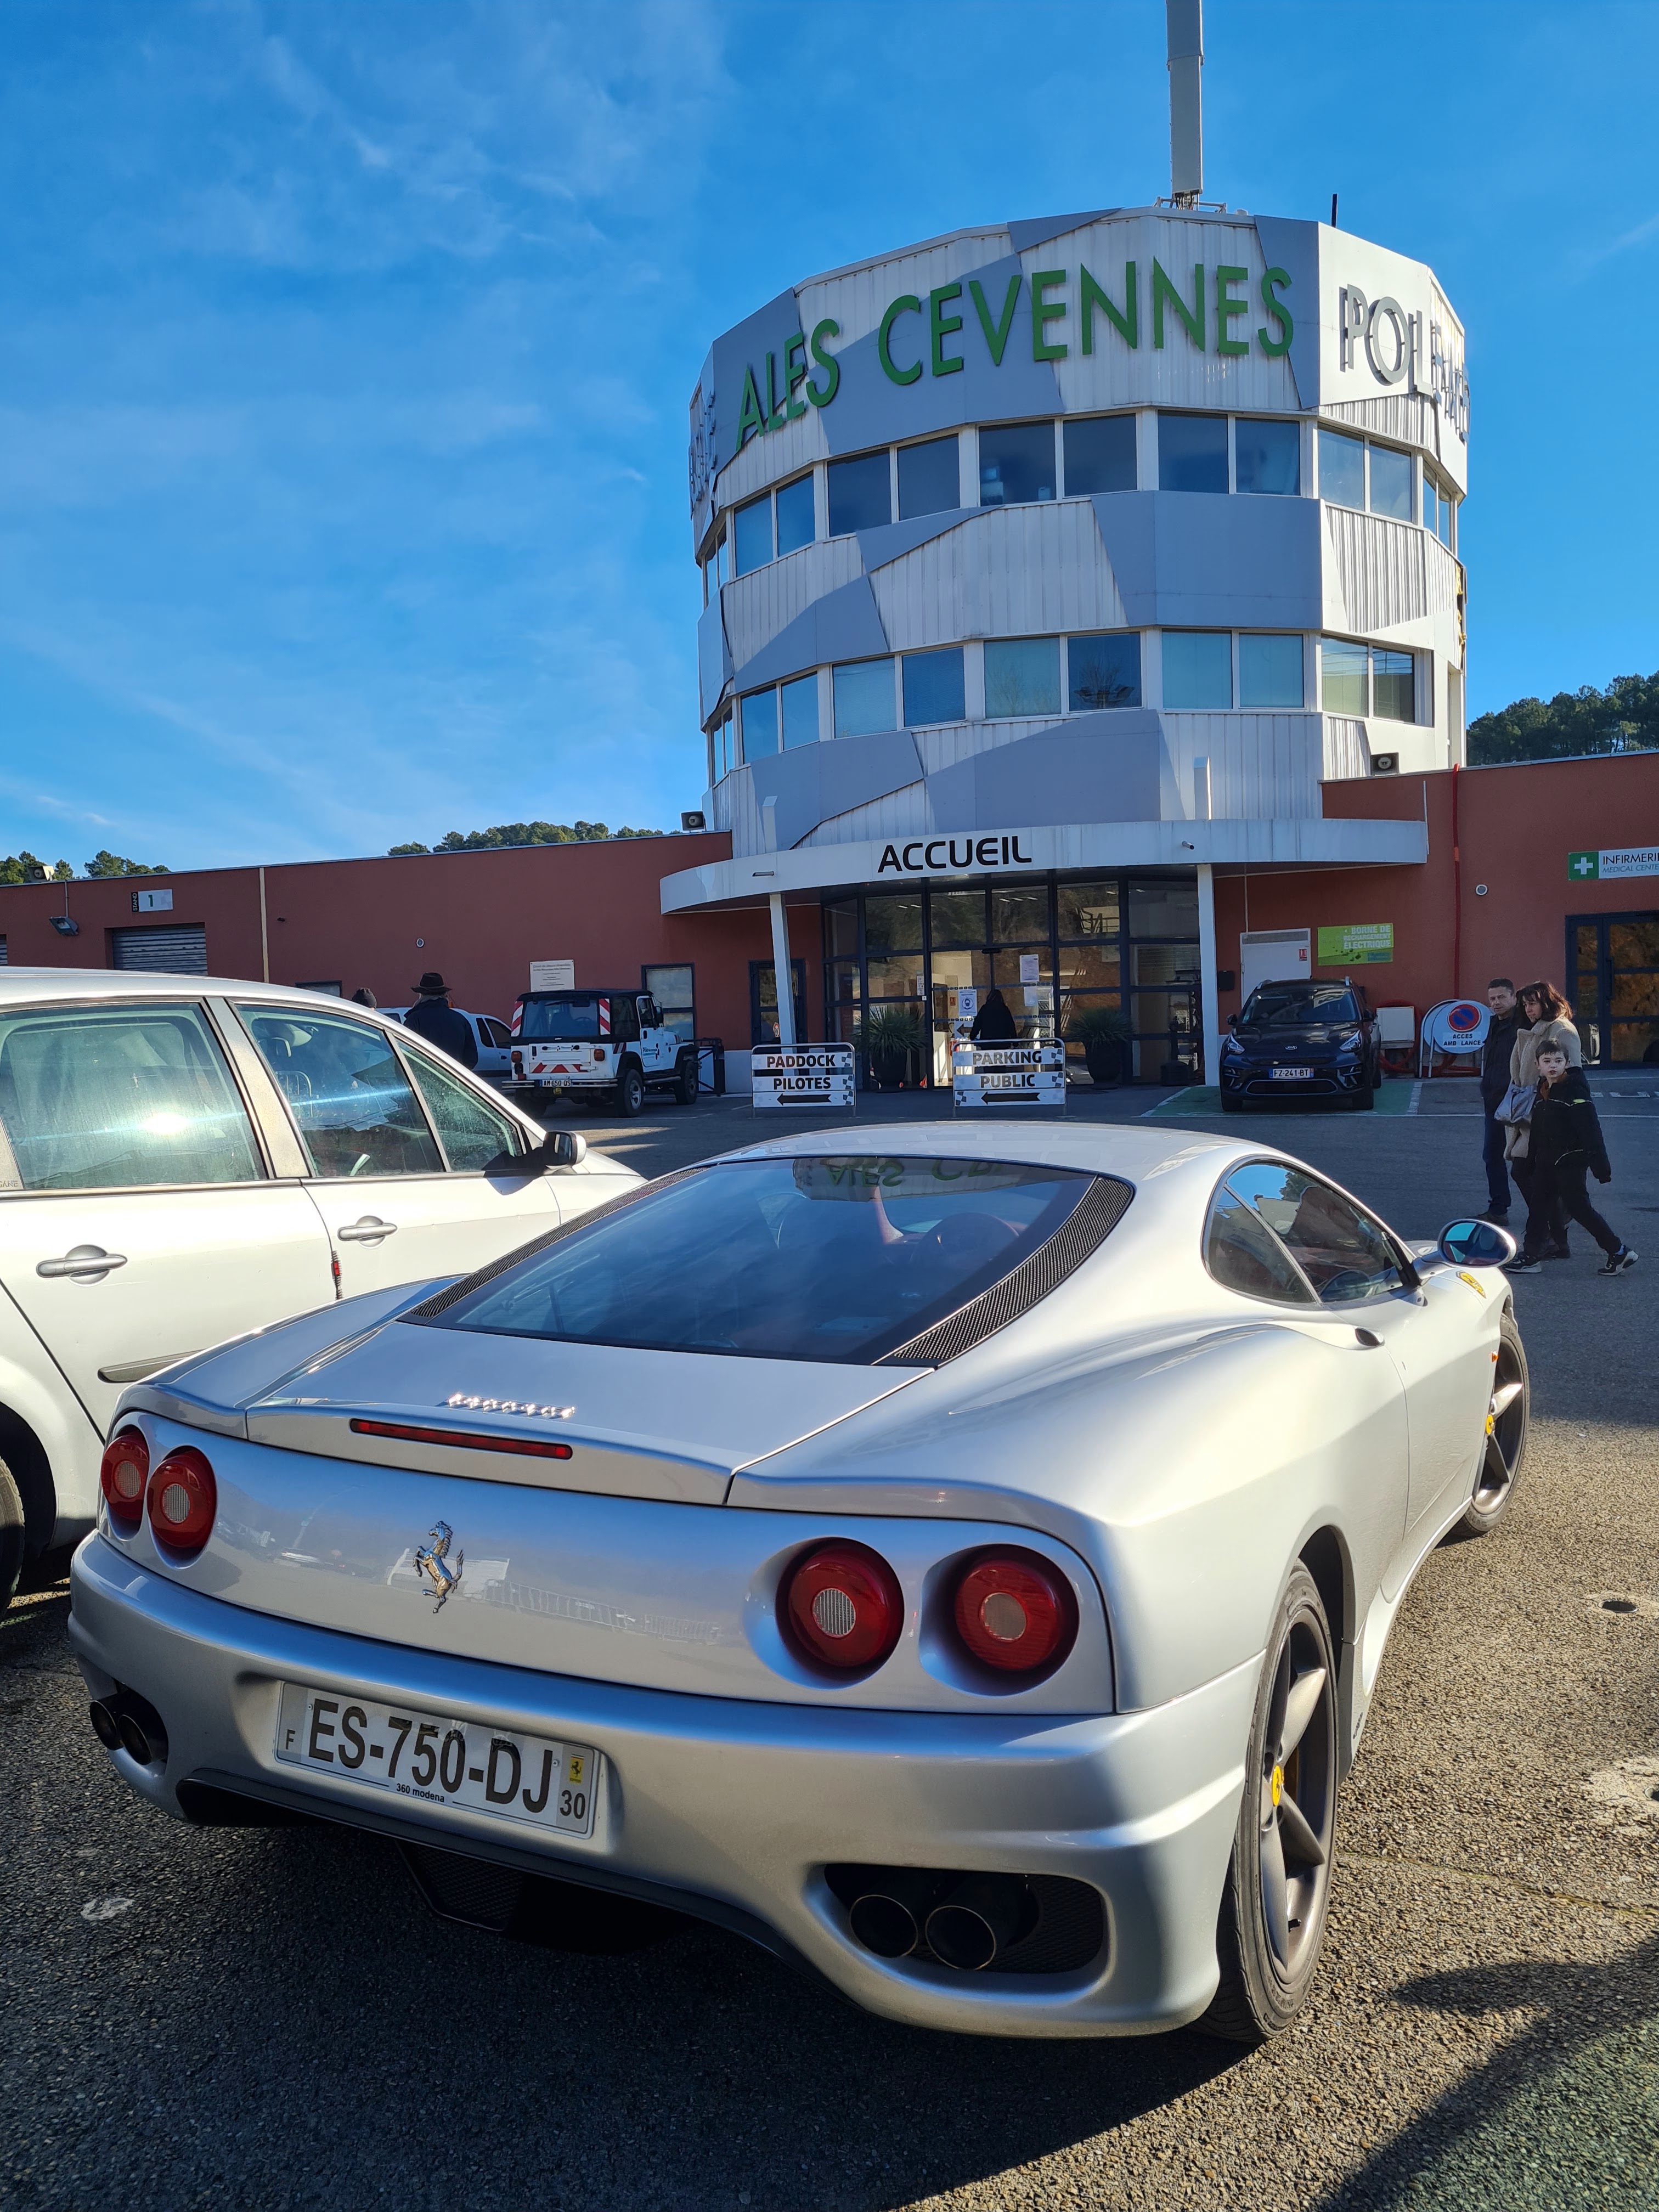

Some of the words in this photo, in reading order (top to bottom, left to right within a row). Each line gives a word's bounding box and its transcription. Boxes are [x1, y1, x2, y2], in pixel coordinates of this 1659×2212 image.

[735, 319, 838, 452] ALES
[878, 256, 1294, 386] CEVENNES
[877, 836, 1032, 873] ACCUEIL
[1602, 865, 1633, 873] MEDICAL
[148, 894, 154, 907] 1
[1351, 926, 1378, 934] BORNE
[766, 1054, 836, 1068] PADDOCK
[972, 1051, 1042, 1065] PARKING
[773, 1077, 831, 1090] PILOTES
[980, 1074, 1035, 1088] PUBLIC
[285, 1729, 295, 1750] F
[308, 1698, 554, 1813] ES-750-DJ
[396, 1782, 410, 1794] 360
[412, 1788, 445, 1803] modena
[559, 1790, 586, 1820] 30
